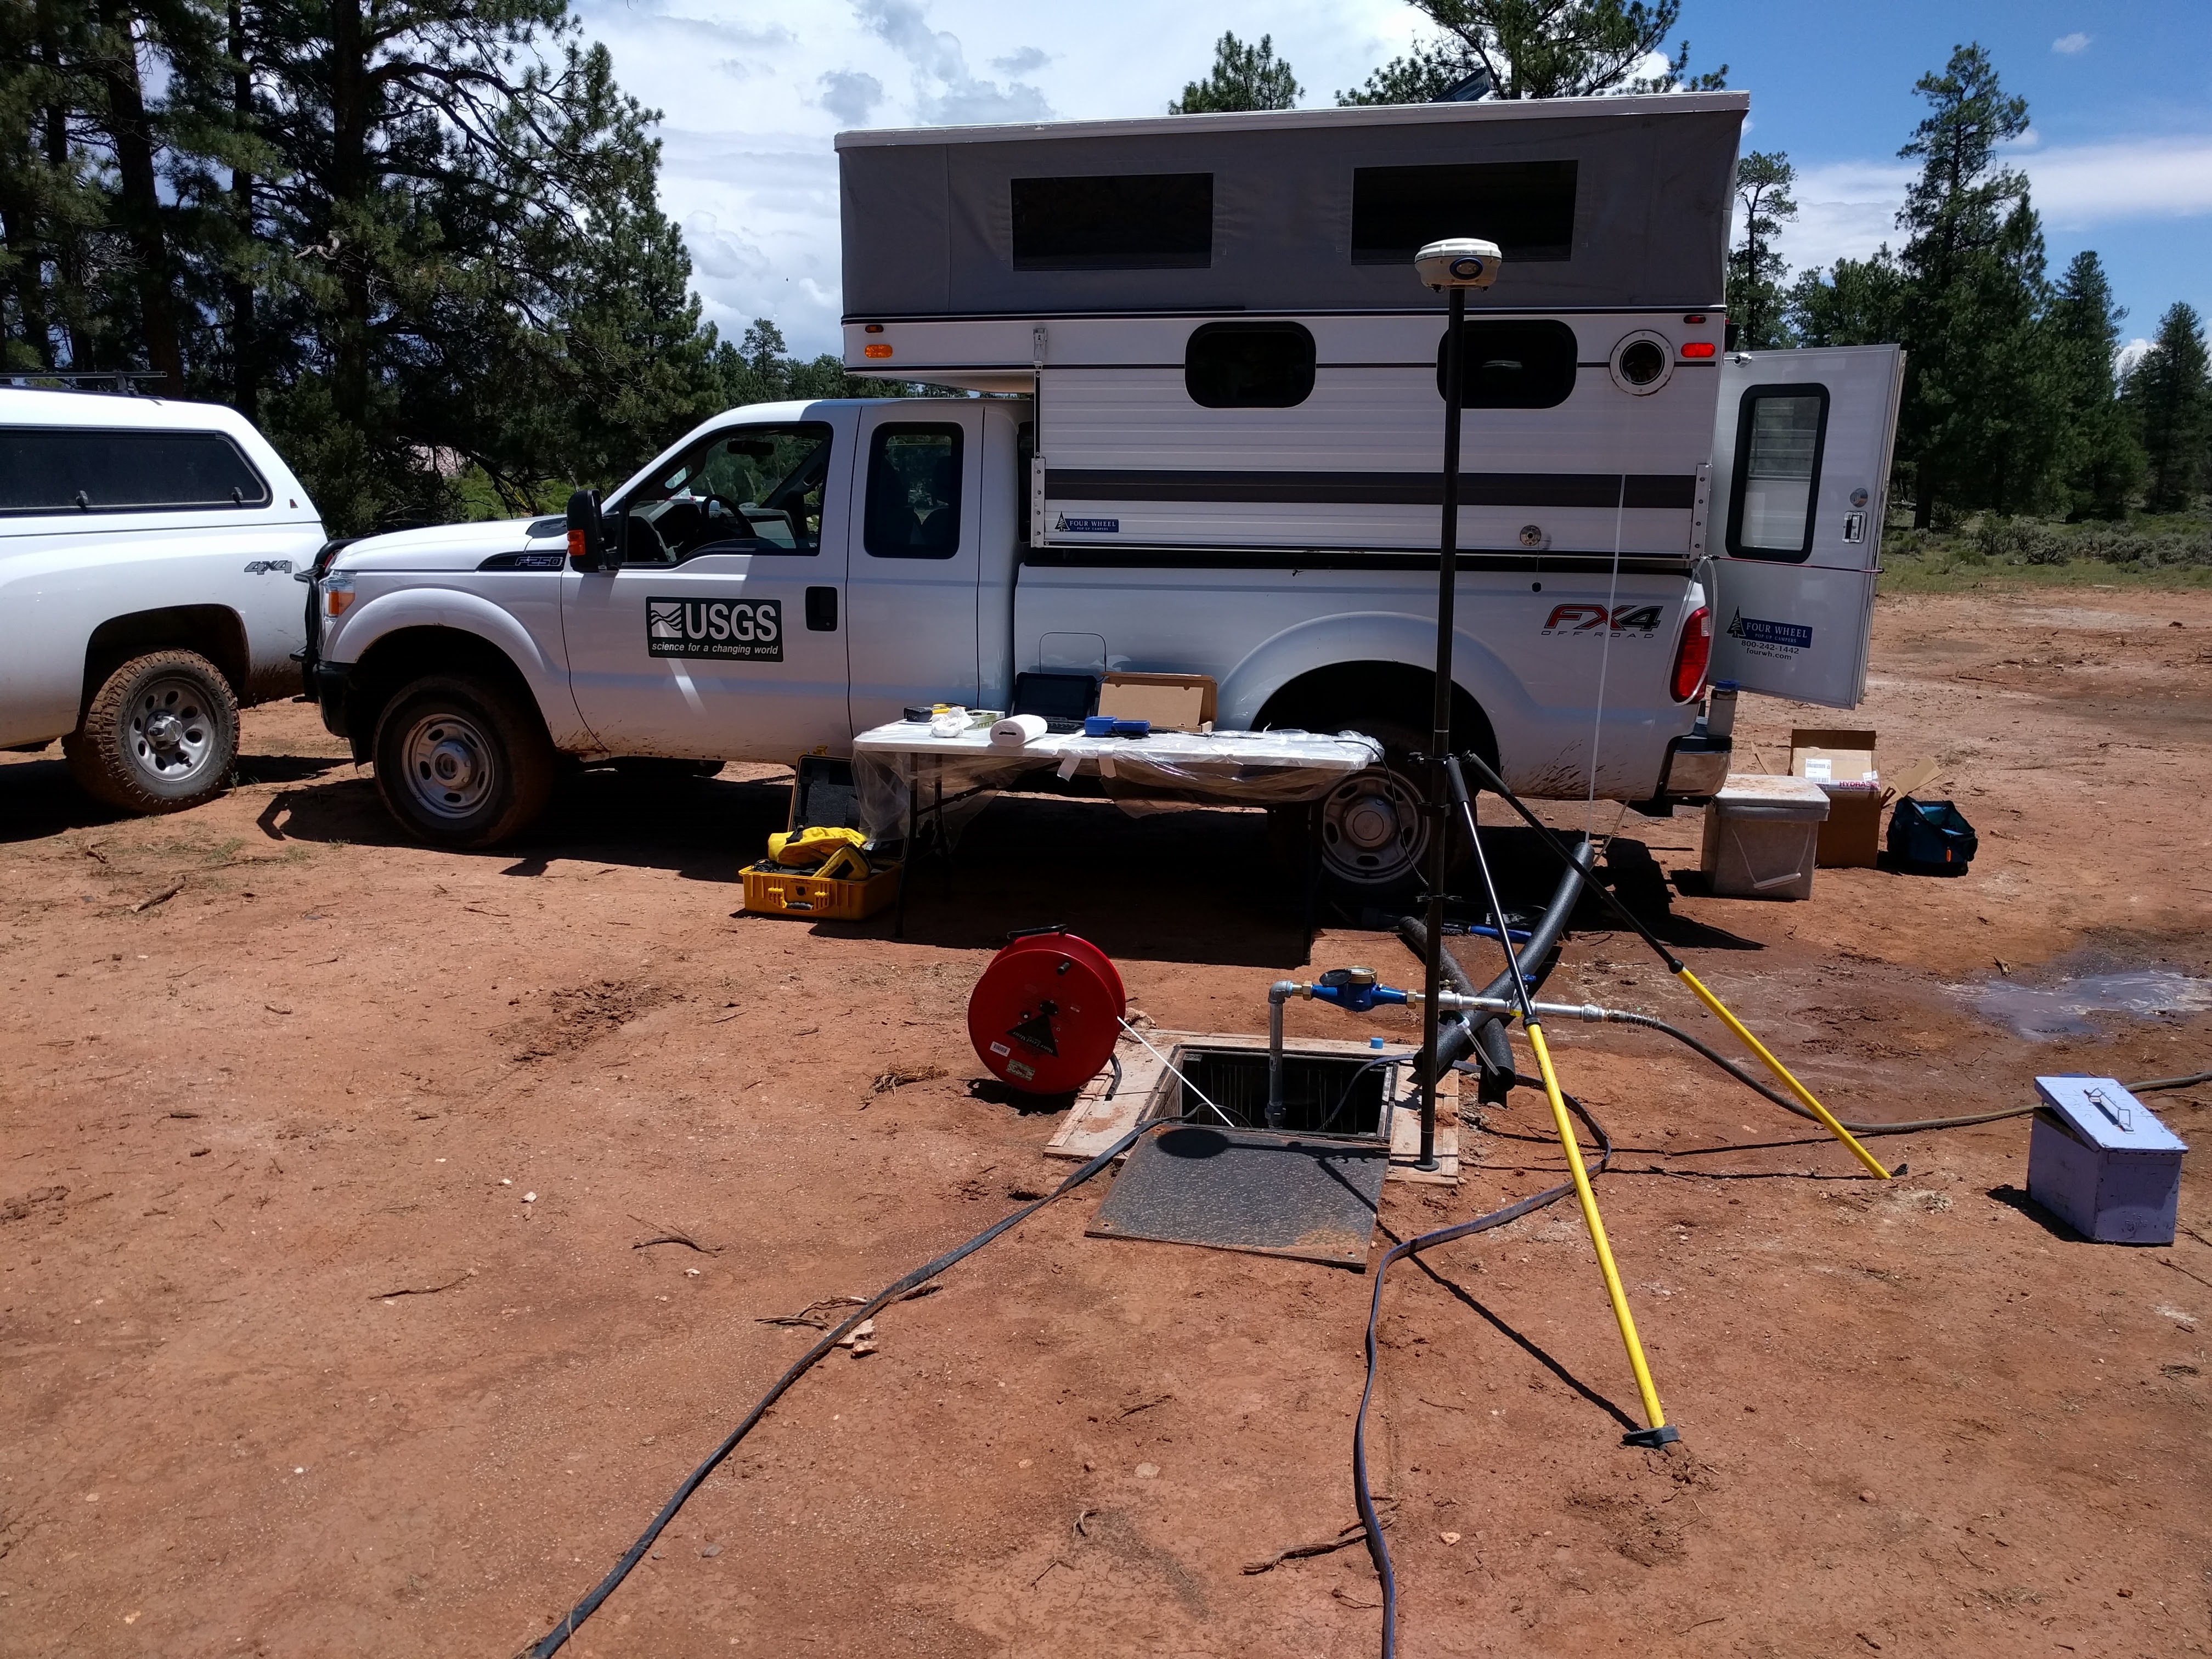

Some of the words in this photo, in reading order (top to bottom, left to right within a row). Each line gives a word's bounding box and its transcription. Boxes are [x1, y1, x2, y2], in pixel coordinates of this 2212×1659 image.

[685, 603, 777, 641] USGS
[1544, 603, 1664, 631] FX4
[1746, 622, 1770, 633] FOUR
[1775, 626, 1808, 638] WHEEL
[652, 642, 685, 651] science
[688, 642, 701, 652] for
[712, 644, 751, 655] changing
[754, 646, 778, 654] world
[1741, 640, 1799, 654] 800-242-1442
[1746, 648, 1792, 660] fourwh.com
